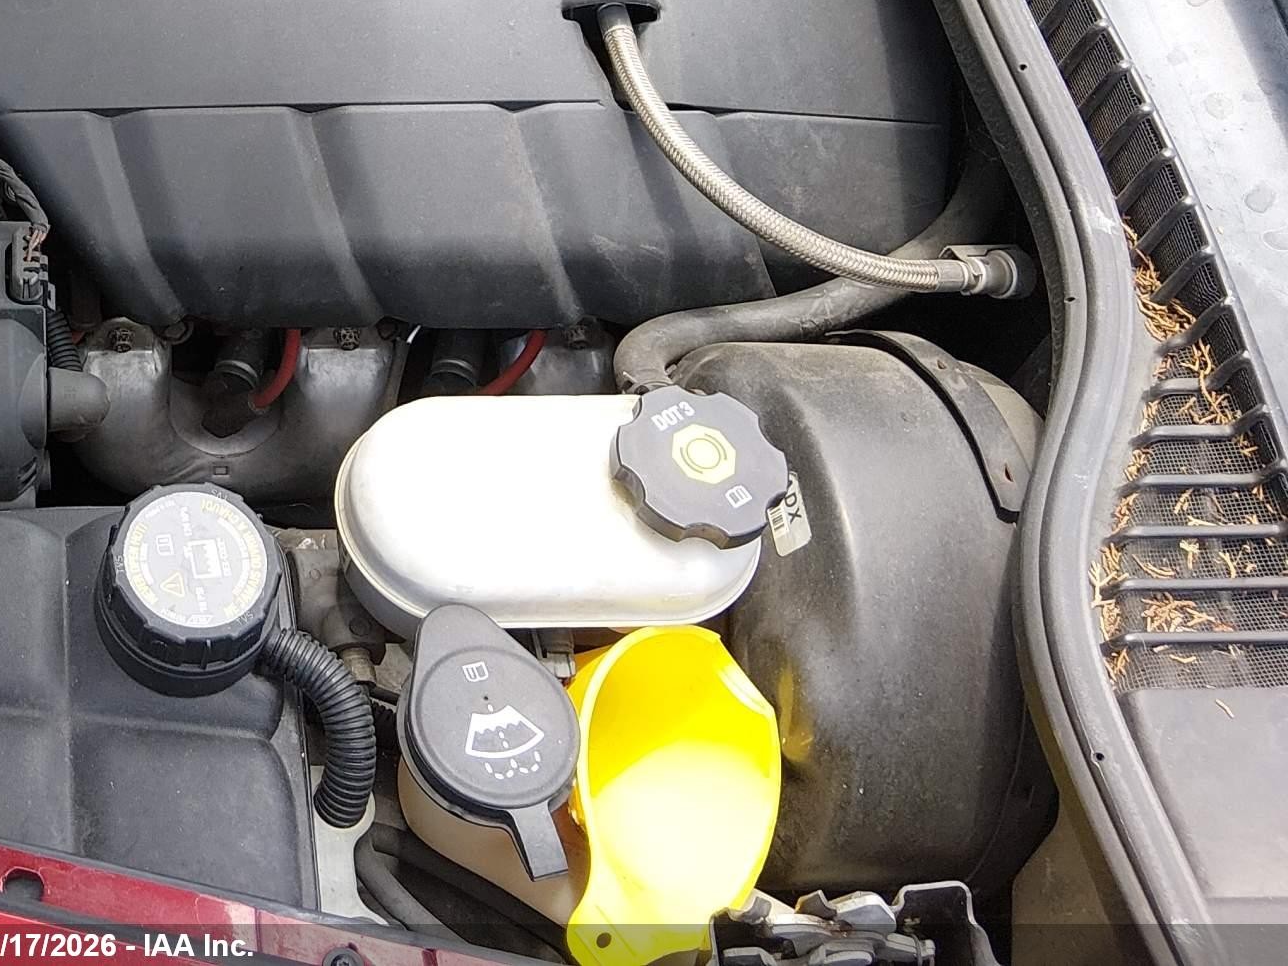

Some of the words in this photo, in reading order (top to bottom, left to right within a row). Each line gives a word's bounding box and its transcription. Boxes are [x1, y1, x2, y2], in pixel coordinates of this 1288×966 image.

[650, 404, 685, 432] DOT
[678, 401, 695, 417] 3
[199, 497, 240, 523] CHAUD!
[130, 522, 149, 545] HOT!
[128, 546, 142, 572] OPEN
[244, 530, 264, 570] OUVRIR
[132, 574, 159, 605] NEVER
[222, 605, 239, 618] NE
